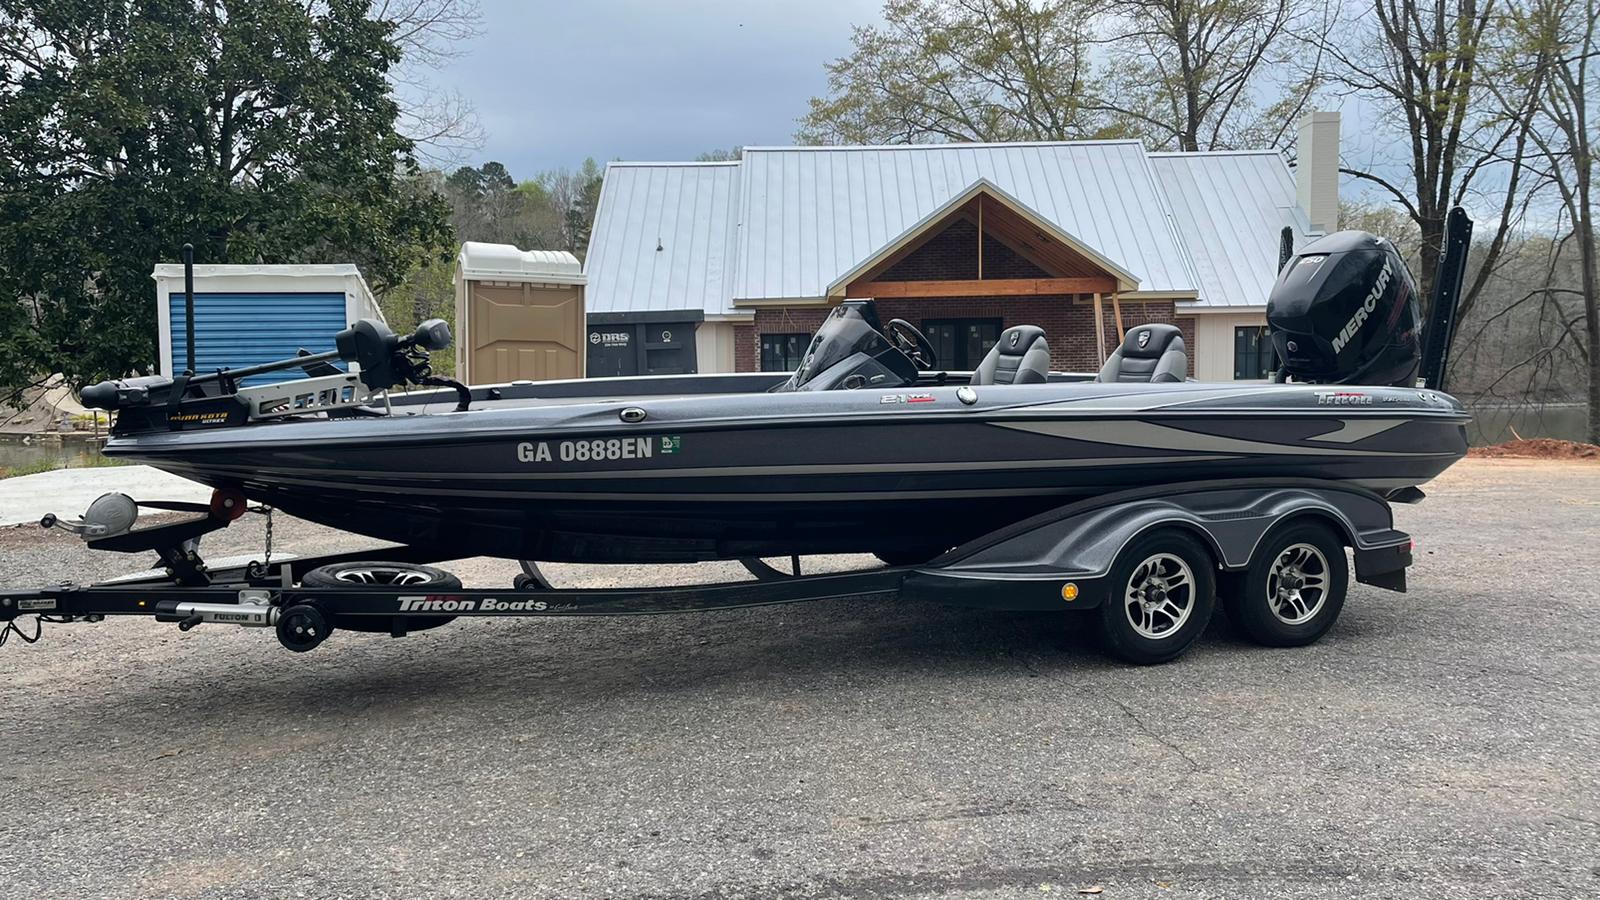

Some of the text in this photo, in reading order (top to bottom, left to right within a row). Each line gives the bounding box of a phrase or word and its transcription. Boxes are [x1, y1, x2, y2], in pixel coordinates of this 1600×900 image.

[1331, 256, 1393, 354] MERCURY
[1313, 391, 1373, 405] Triton
[517, 442, 552, 463] GA
[559, 437, 652, 462] 0888EN
[397, 596, 476, 611] Triton
[479, 598, 548, 611] Boats
